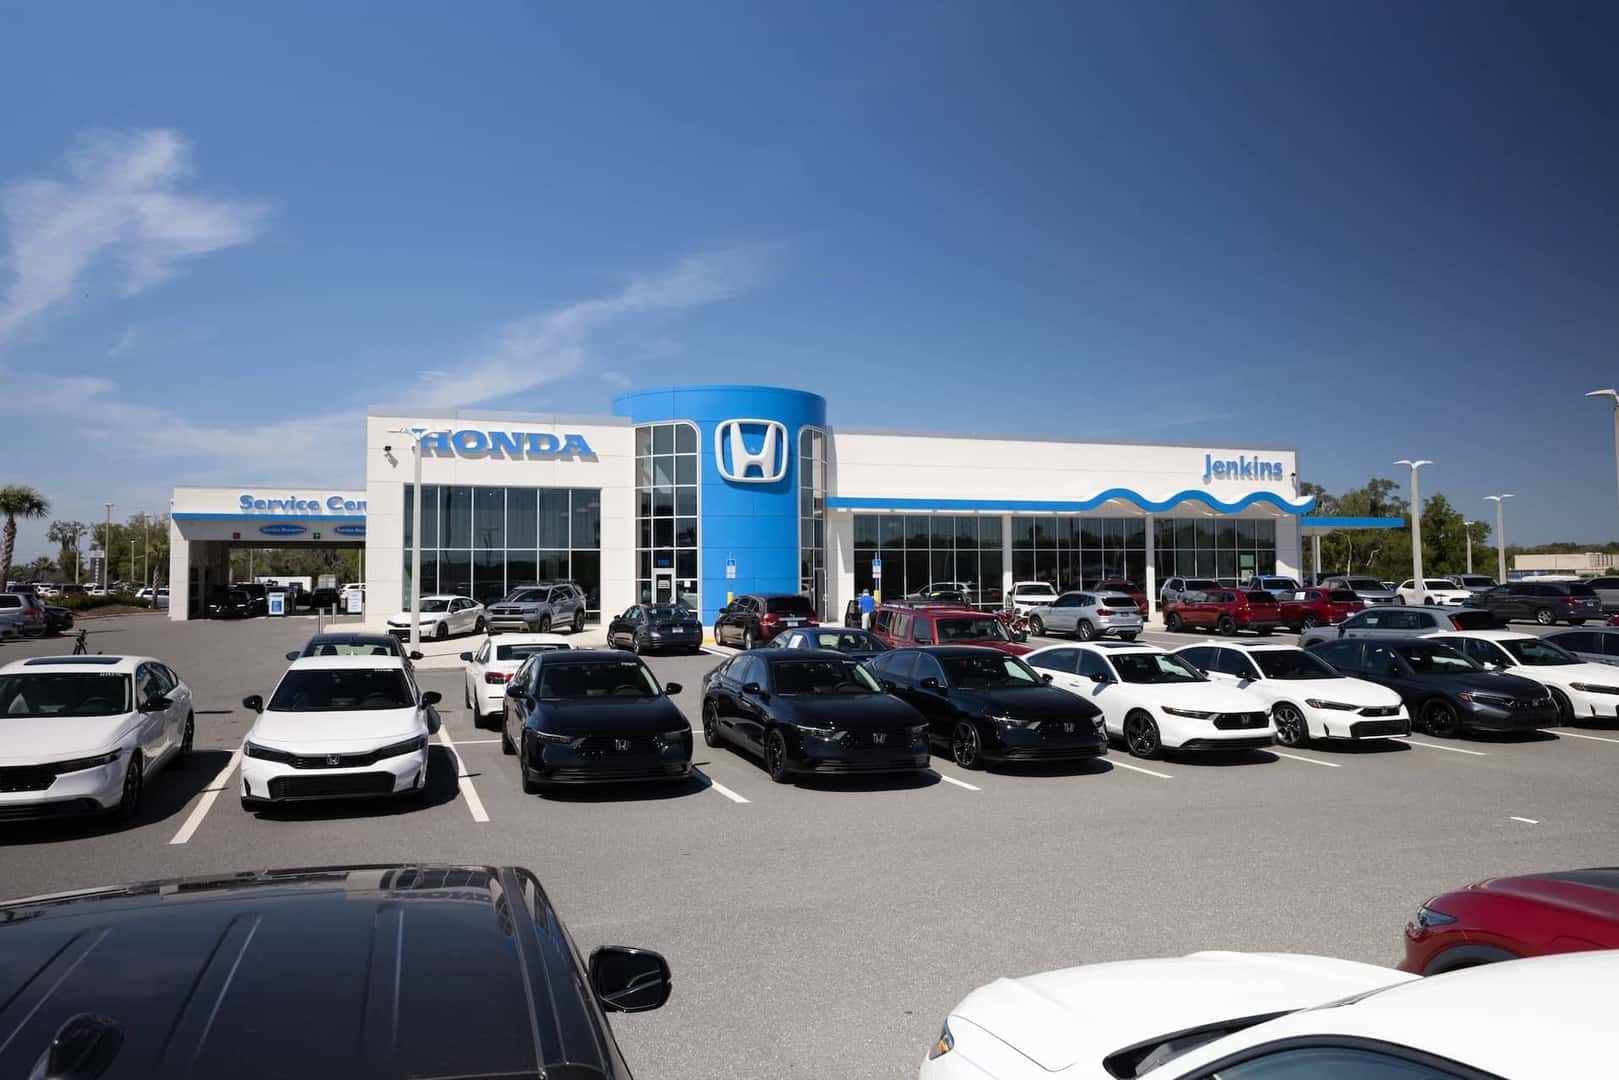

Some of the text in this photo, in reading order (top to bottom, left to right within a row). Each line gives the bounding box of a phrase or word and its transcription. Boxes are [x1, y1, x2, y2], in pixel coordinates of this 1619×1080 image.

[412, 428, 598, 459] HONDA
[1203, 453, 1284, 480] Jenkins
[239, 495, 320, 511] Service
